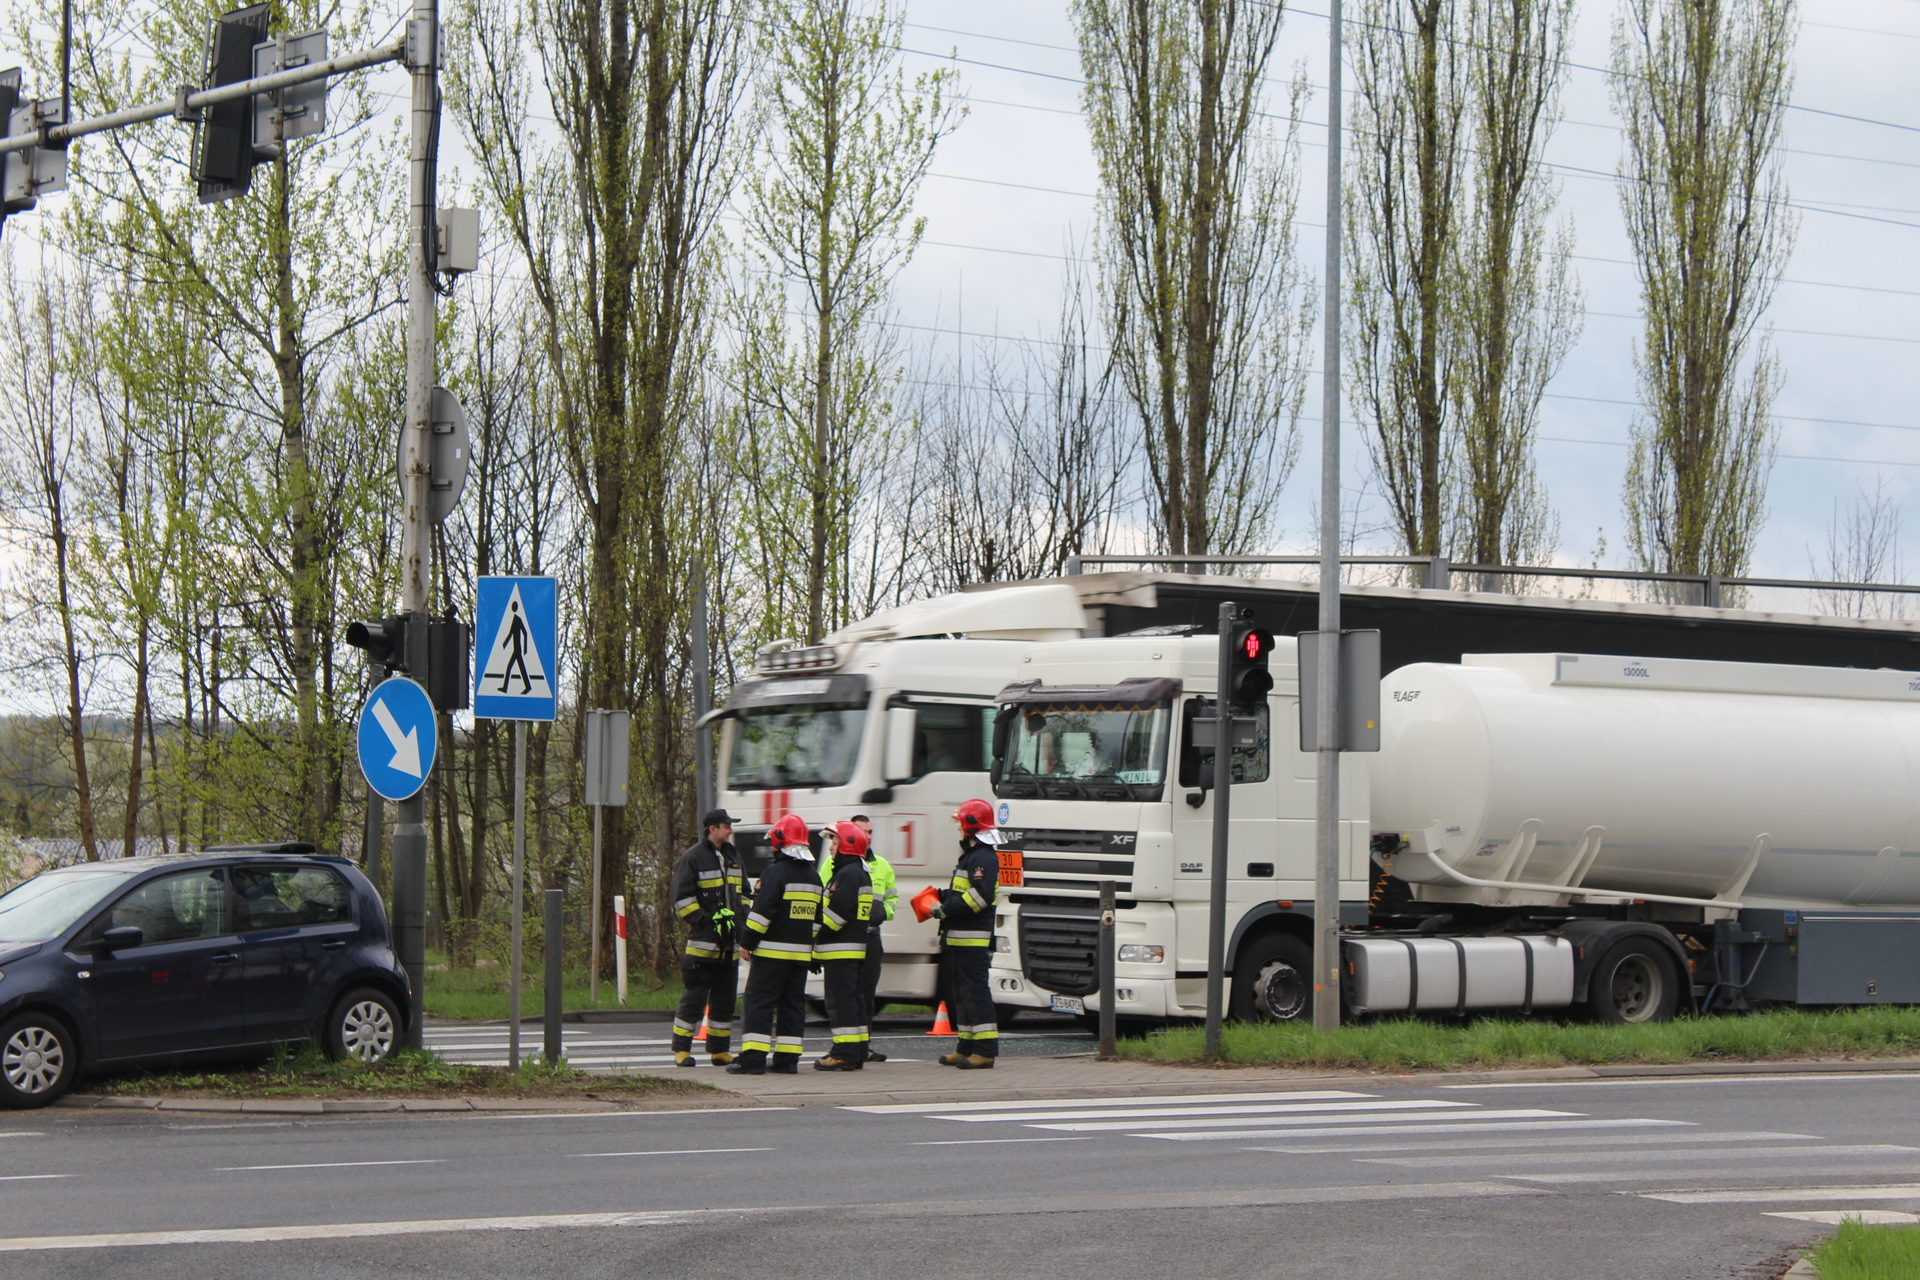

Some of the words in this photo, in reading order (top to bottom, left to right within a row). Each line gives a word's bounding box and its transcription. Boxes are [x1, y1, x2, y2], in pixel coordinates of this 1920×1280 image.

[1623, 667, 1650, 677] 13000L
[1395, 691, 1416, 702] LAG
[898, 820, 917, 858] 1
[1110, 835, 1135, 845] XF
[1003, 853, 1013, 866] 30
[1001, 871, 1020, 884] 1202
